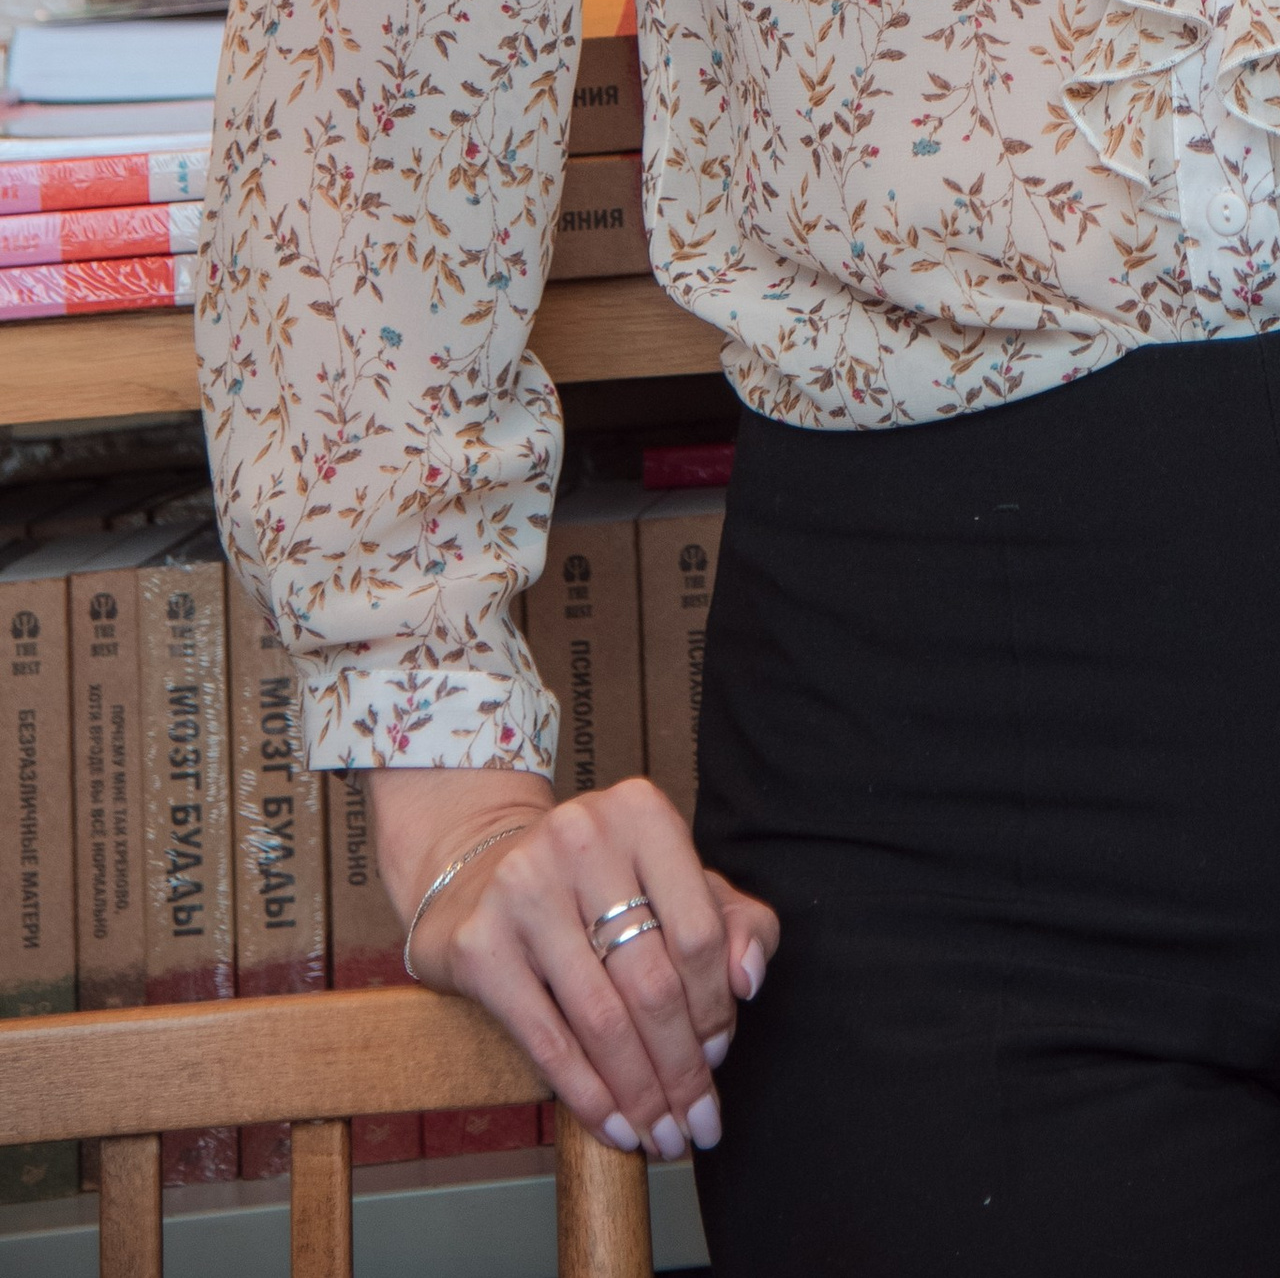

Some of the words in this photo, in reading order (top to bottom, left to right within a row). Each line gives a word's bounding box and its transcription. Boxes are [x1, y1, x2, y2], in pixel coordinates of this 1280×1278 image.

[167, 684, 201, 791] МОЗГ
[260, 677, 294, 782] МОЗГ
[571, 640, 595, 791] ПСИХОЛОГИЯ
[18, 709, 39, 866] БЕЗРАЗЛИЧНЫЕ
[112, 771, 127, 804] МНЕ
[22, 871, 40, 950] МАТЕРИ
[92, 842, 108, 939] НОРМАЛЬНО
[164, 803, 204, 938] БУДДЫ
